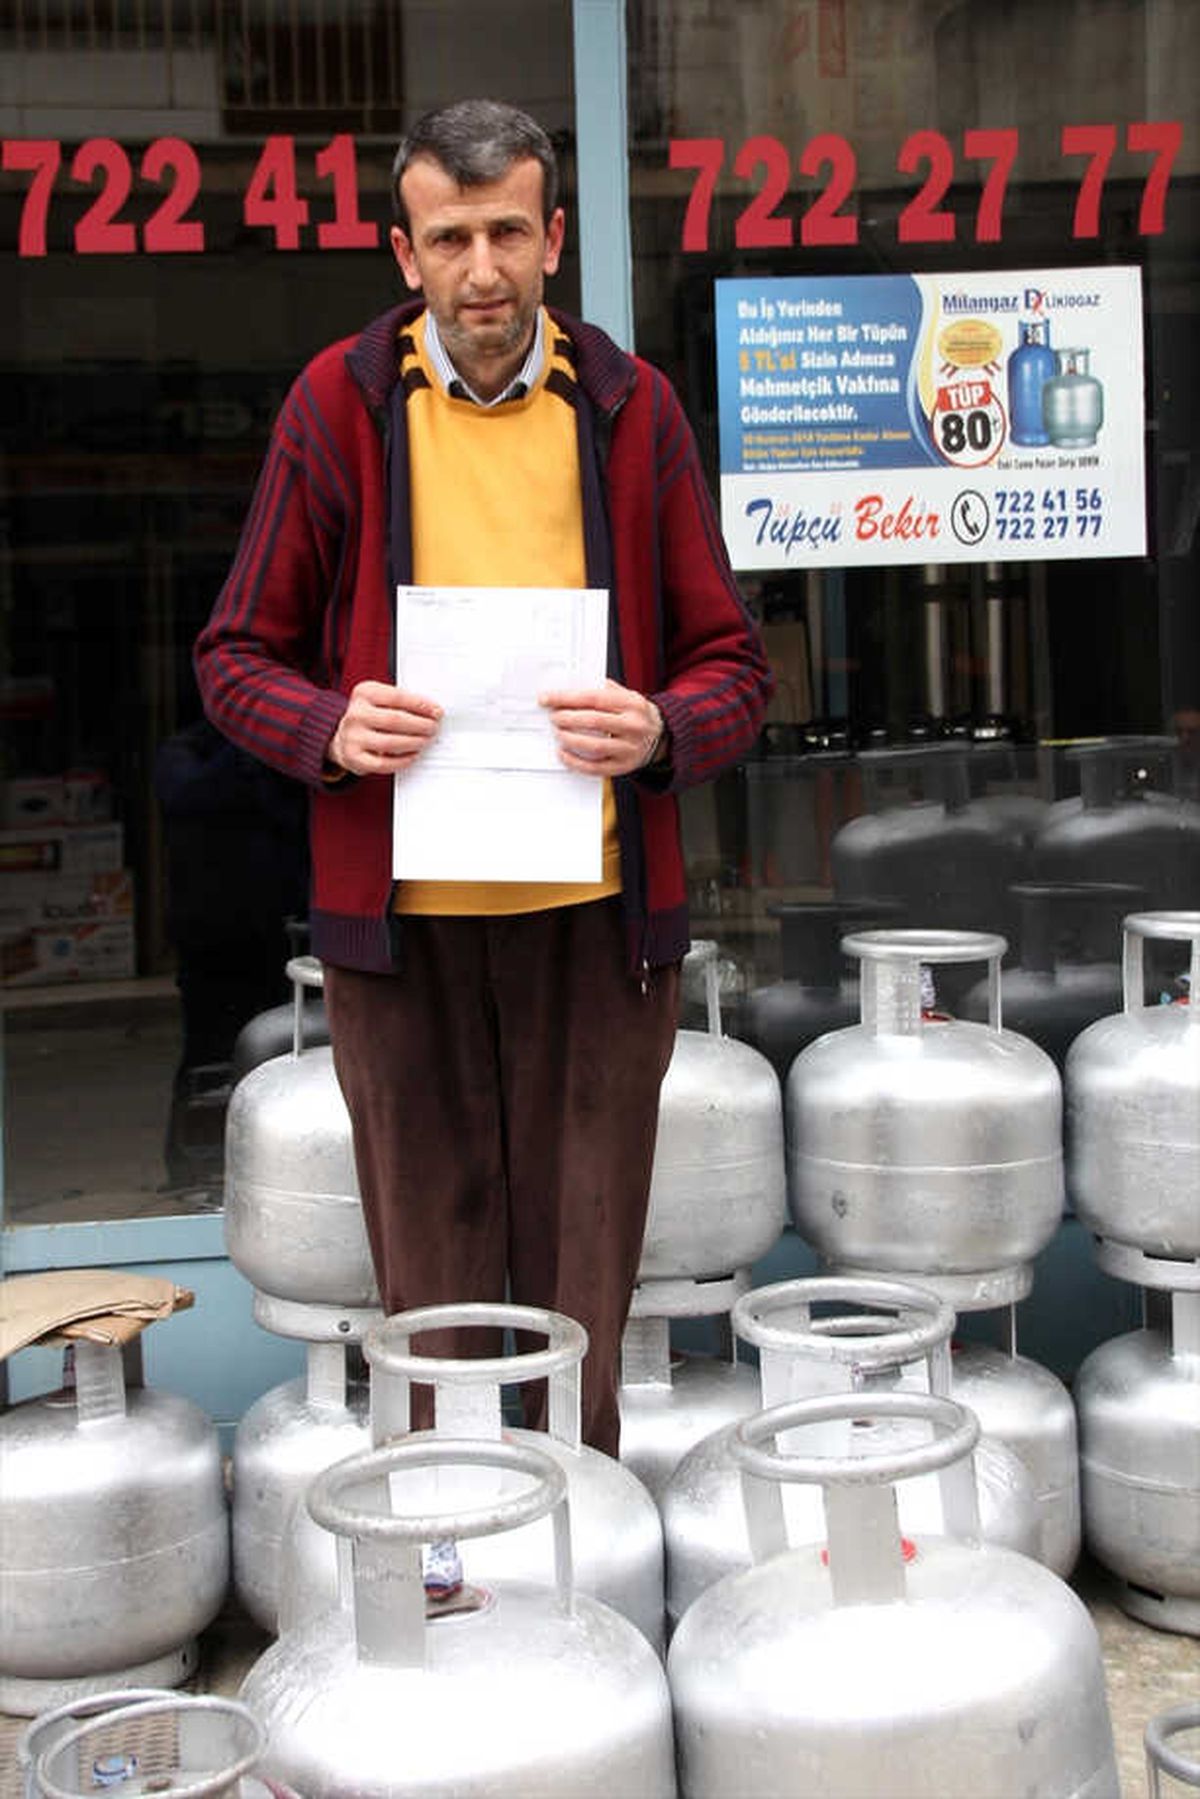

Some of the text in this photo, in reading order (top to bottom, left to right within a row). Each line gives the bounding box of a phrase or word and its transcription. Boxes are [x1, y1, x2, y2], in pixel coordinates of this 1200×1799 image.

[2, 134, 379, 257] 722 41
[669, 123, 1183, 252] 722 27 77
[947, 381, 985, 409] TÜP
[995, 488, 1102, 513] 722 41 56
[745, 495, 941, 557] Tüpçü Bekir
[996, 515, 1102, 540] 722 27 77
